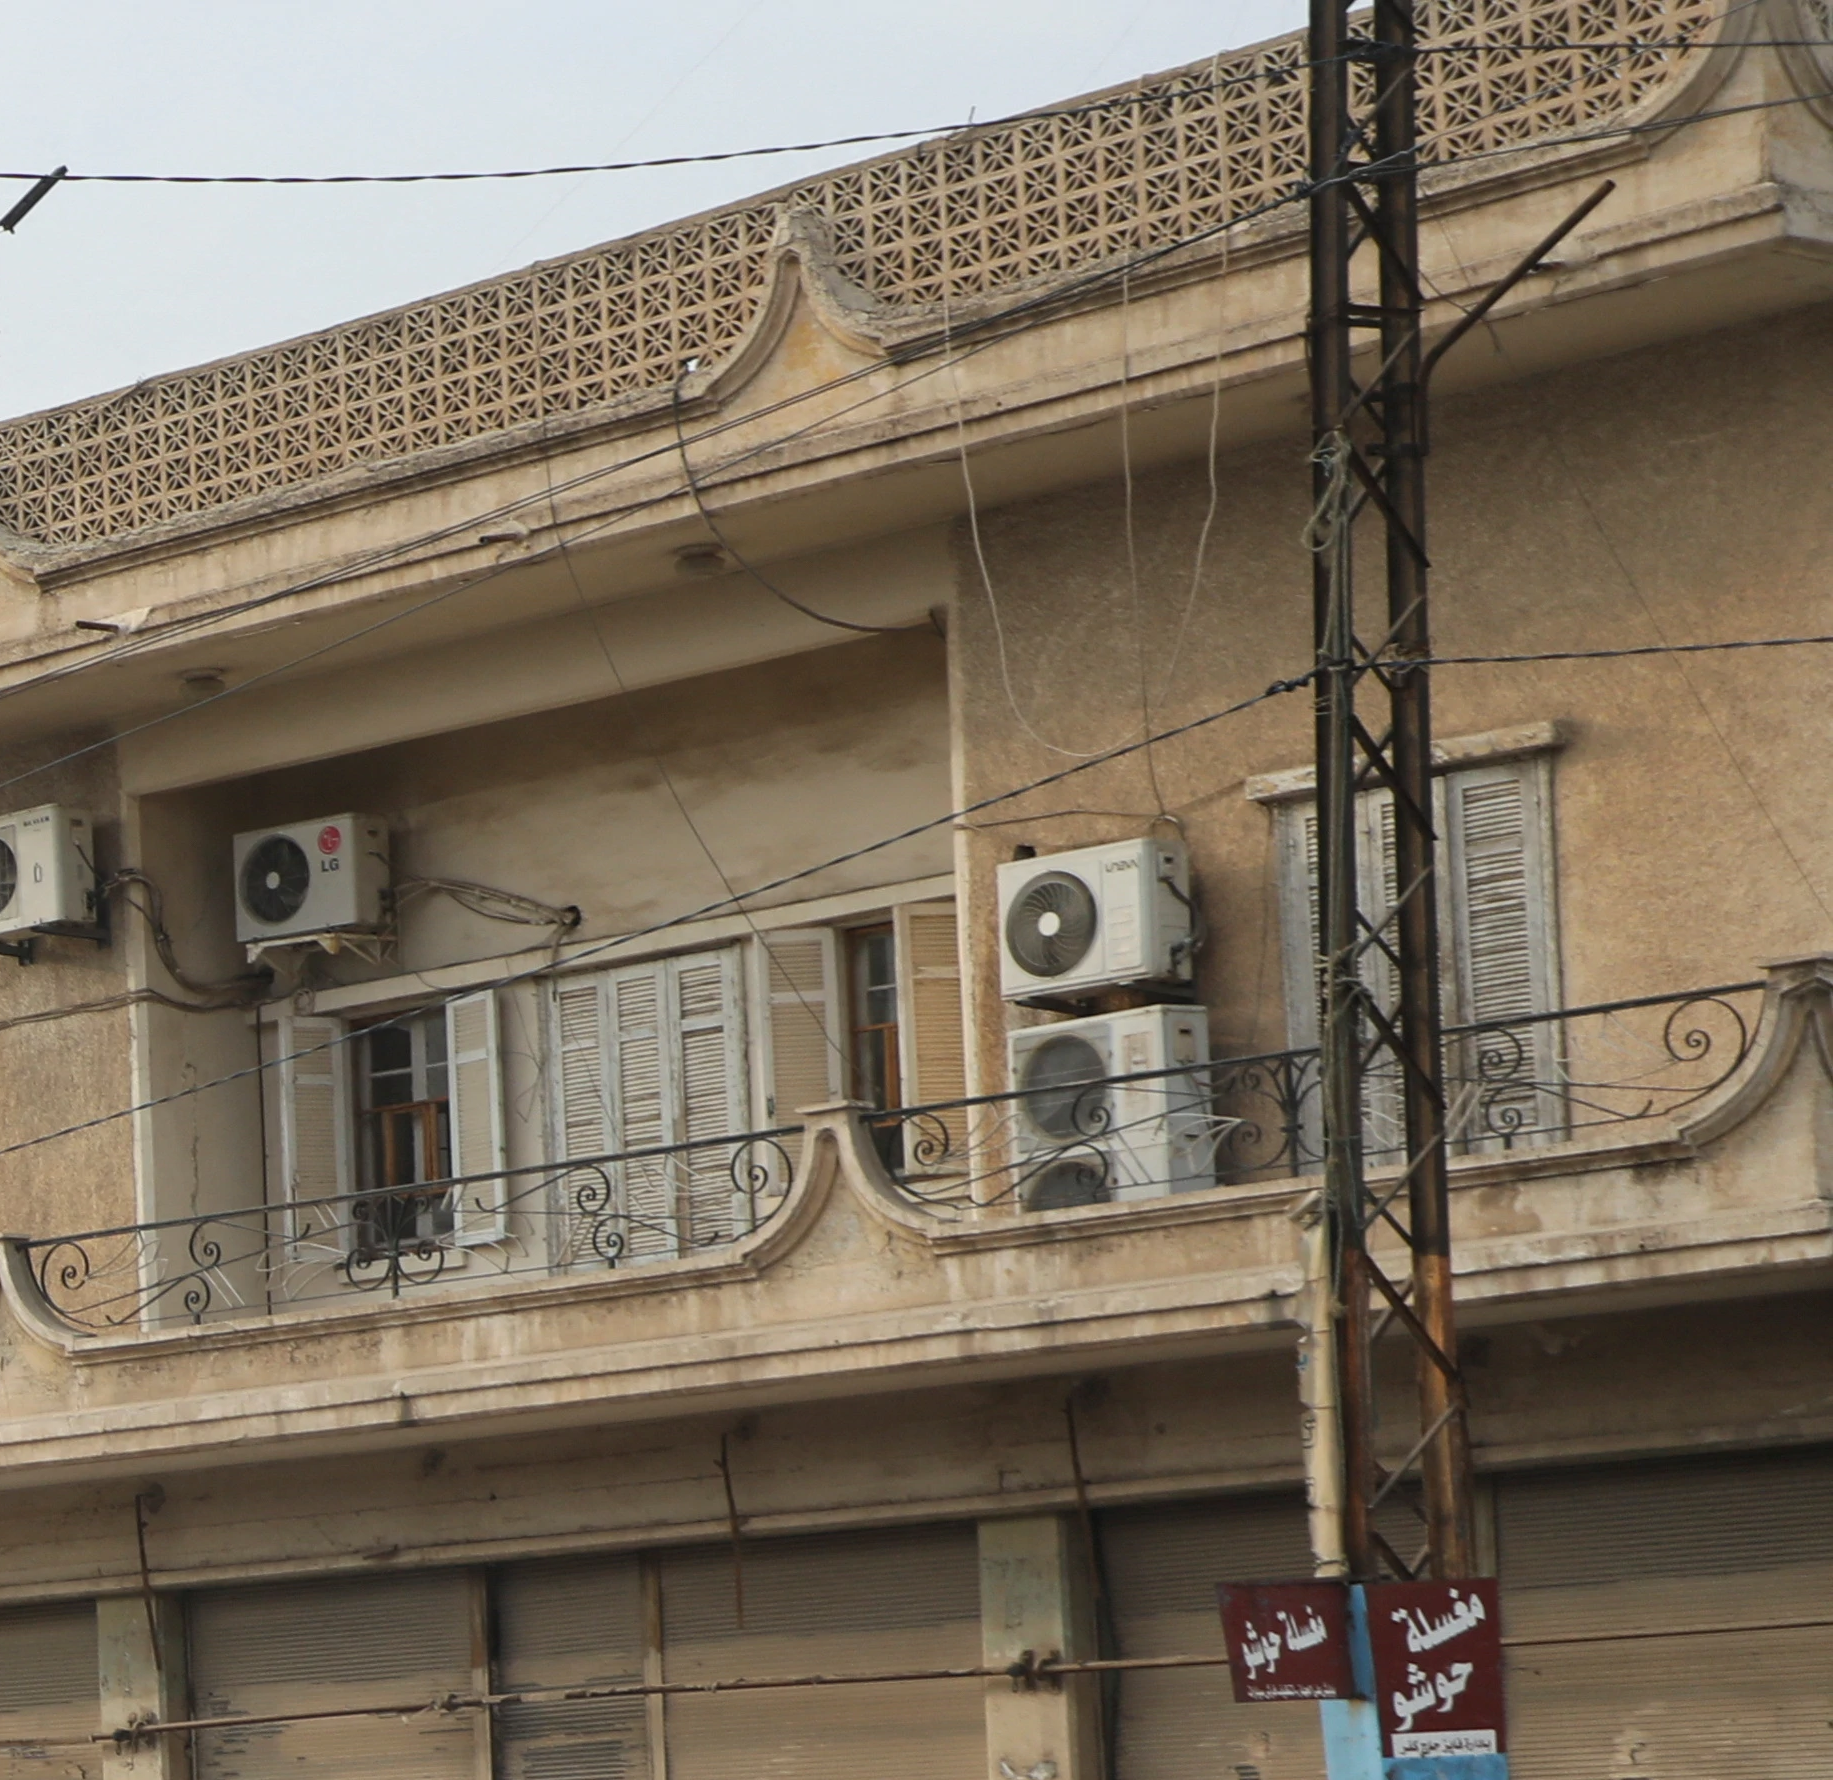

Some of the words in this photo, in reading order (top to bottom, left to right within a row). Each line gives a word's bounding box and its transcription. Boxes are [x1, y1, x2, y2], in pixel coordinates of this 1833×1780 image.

[321, 857, 340, 873] LG
[1276, 1604, 1328, 1651] مغسلة
[1391, 1587, 1486, 1653] مغسلة
[1393, 1662, 1473, 1732] حوشو
